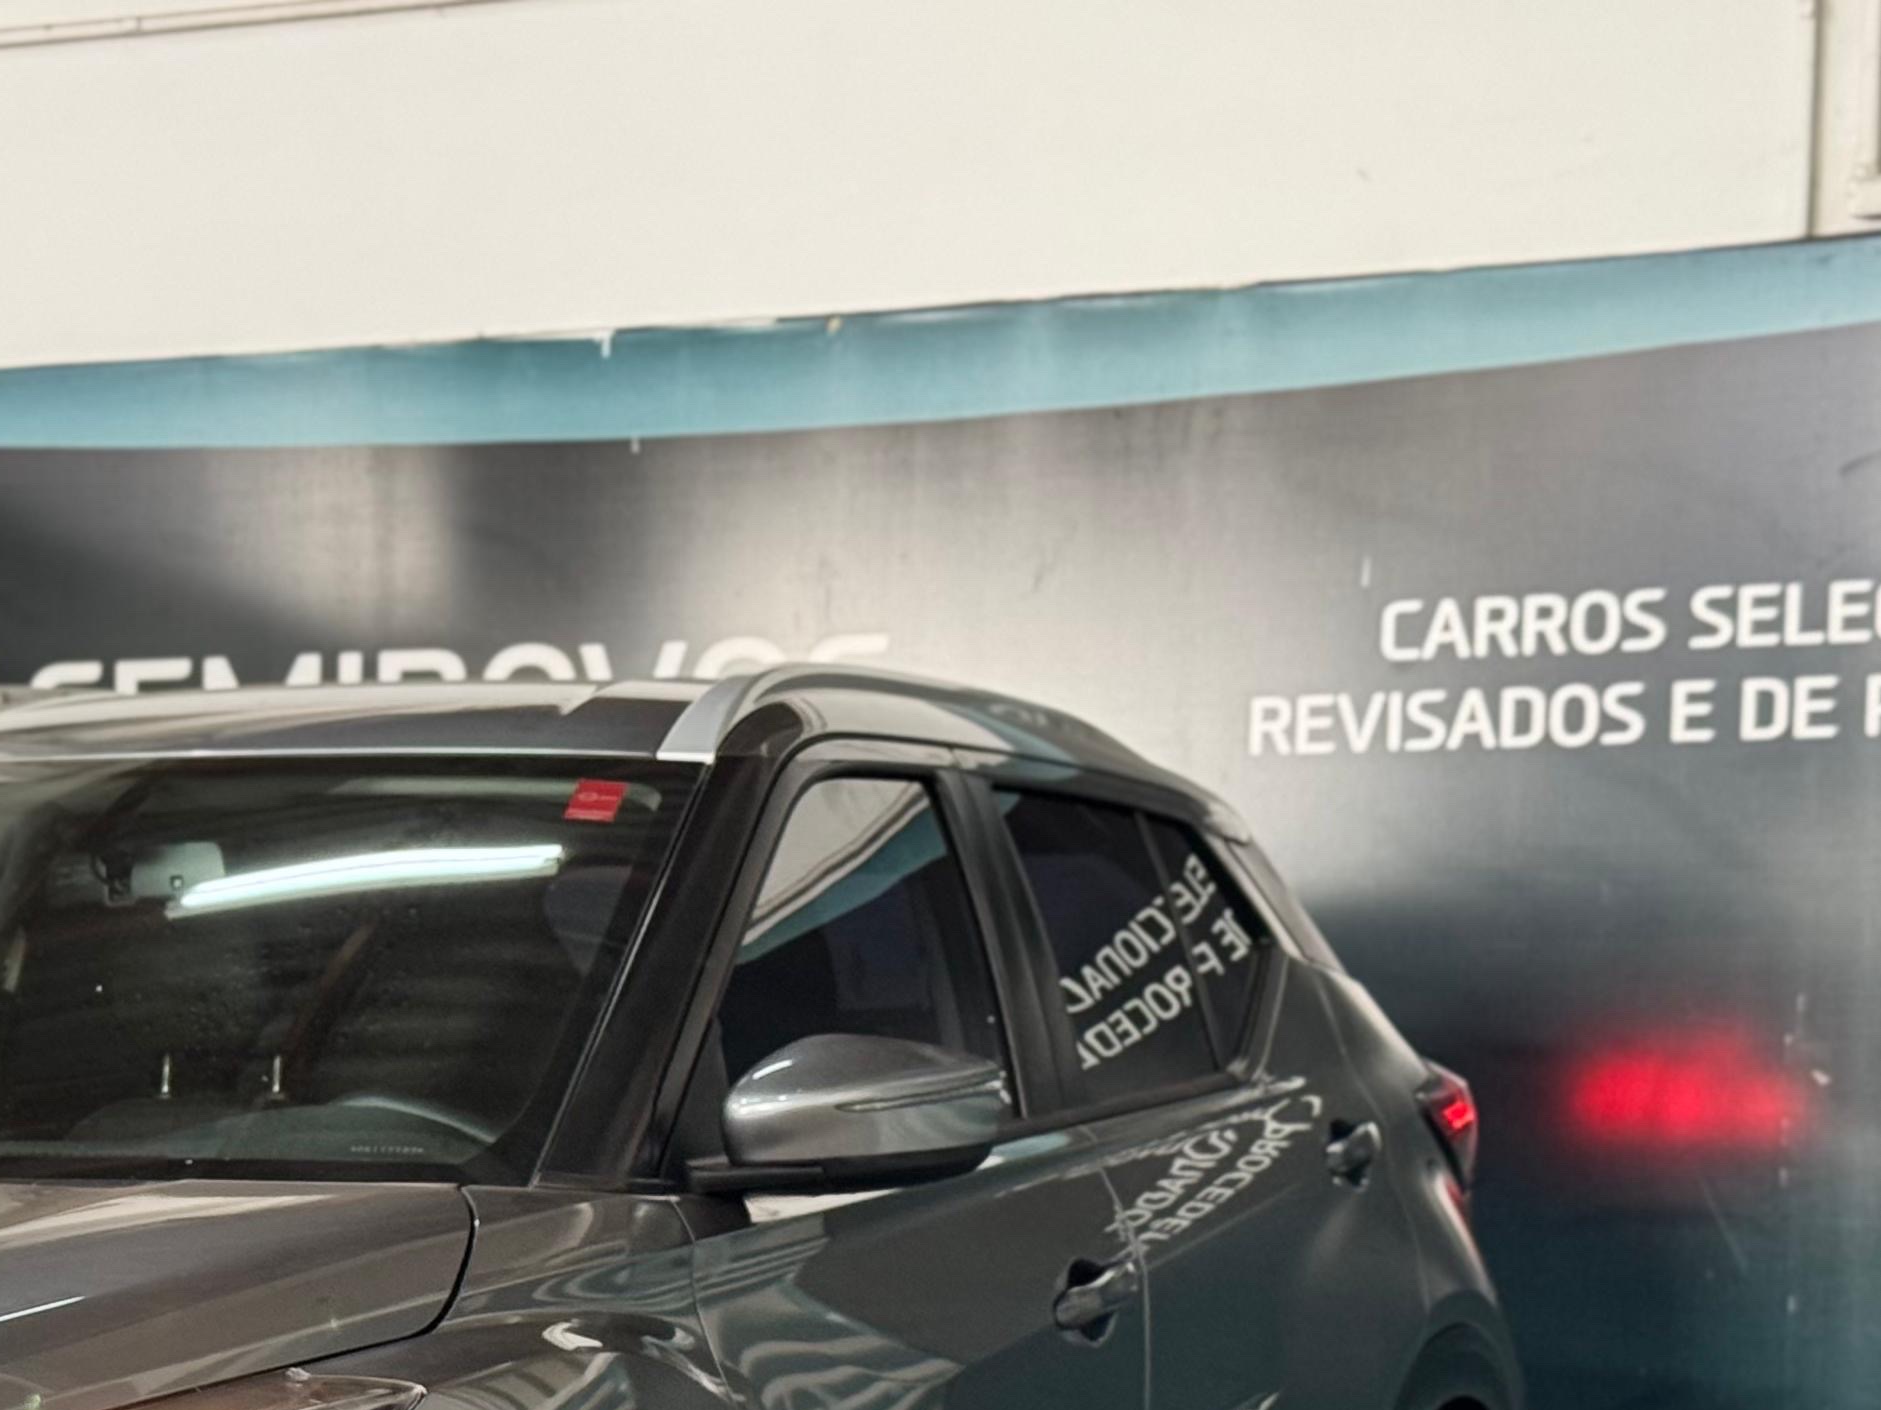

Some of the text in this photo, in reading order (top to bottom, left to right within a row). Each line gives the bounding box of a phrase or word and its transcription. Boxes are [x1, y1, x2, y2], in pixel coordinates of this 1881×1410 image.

[1380, 578, 1881, 661] CARROS SELE
[1248, 682, 1646, 756] REVISADOS
[1669, 679, 1717, 743] E
[1739, 675, 1840, 741] DE
